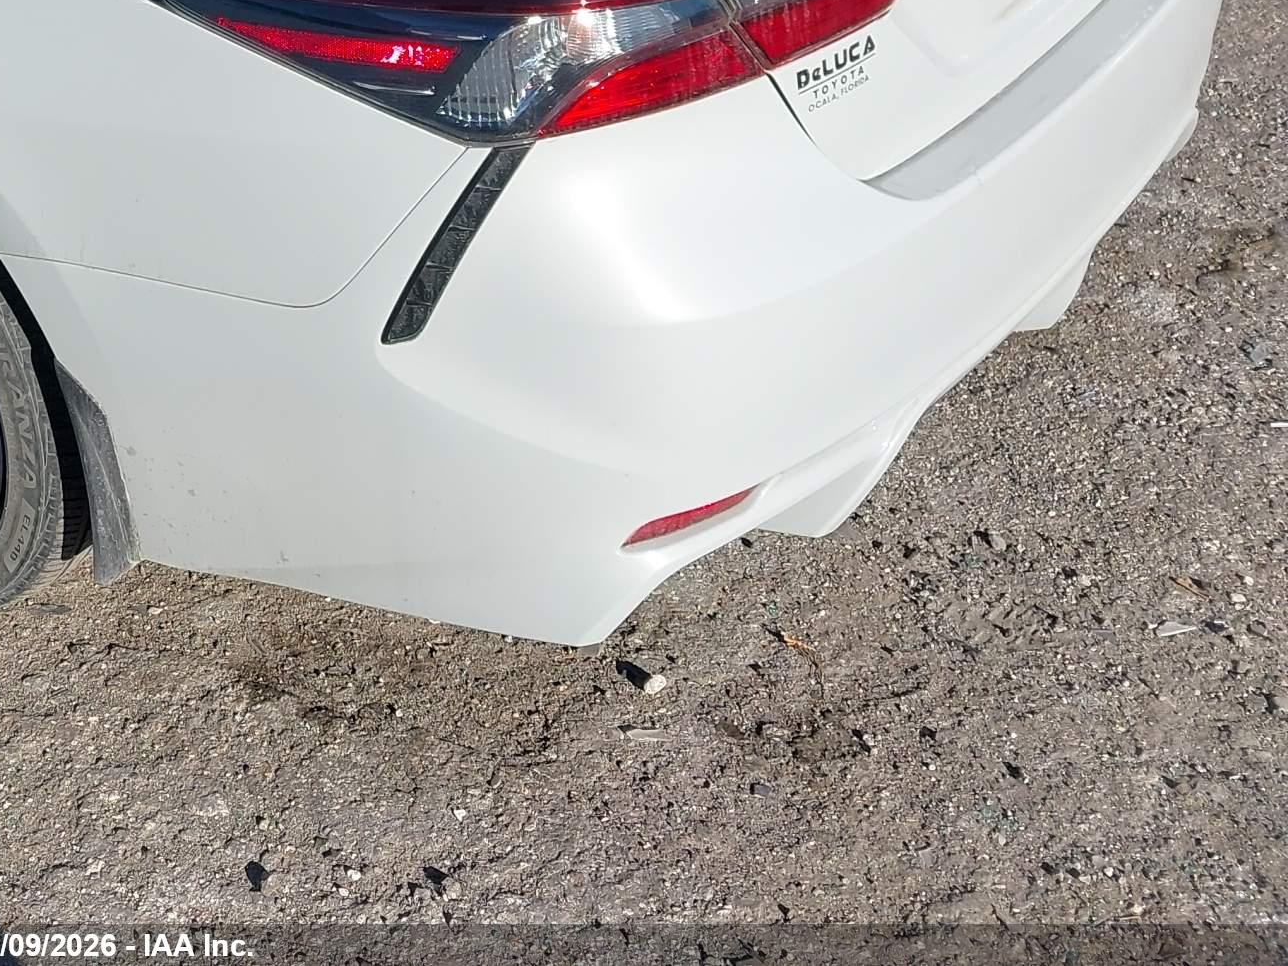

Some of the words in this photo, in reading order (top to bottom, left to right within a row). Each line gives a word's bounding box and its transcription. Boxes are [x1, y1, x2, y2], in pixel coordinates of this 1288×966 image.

[796, 35, 875, 90] DeLUCA
[808, 94, 840, 112] OCALA,
[840, 75, 869, 96] FLORIDA
[813, 65, 864, 99] TOYOTA
